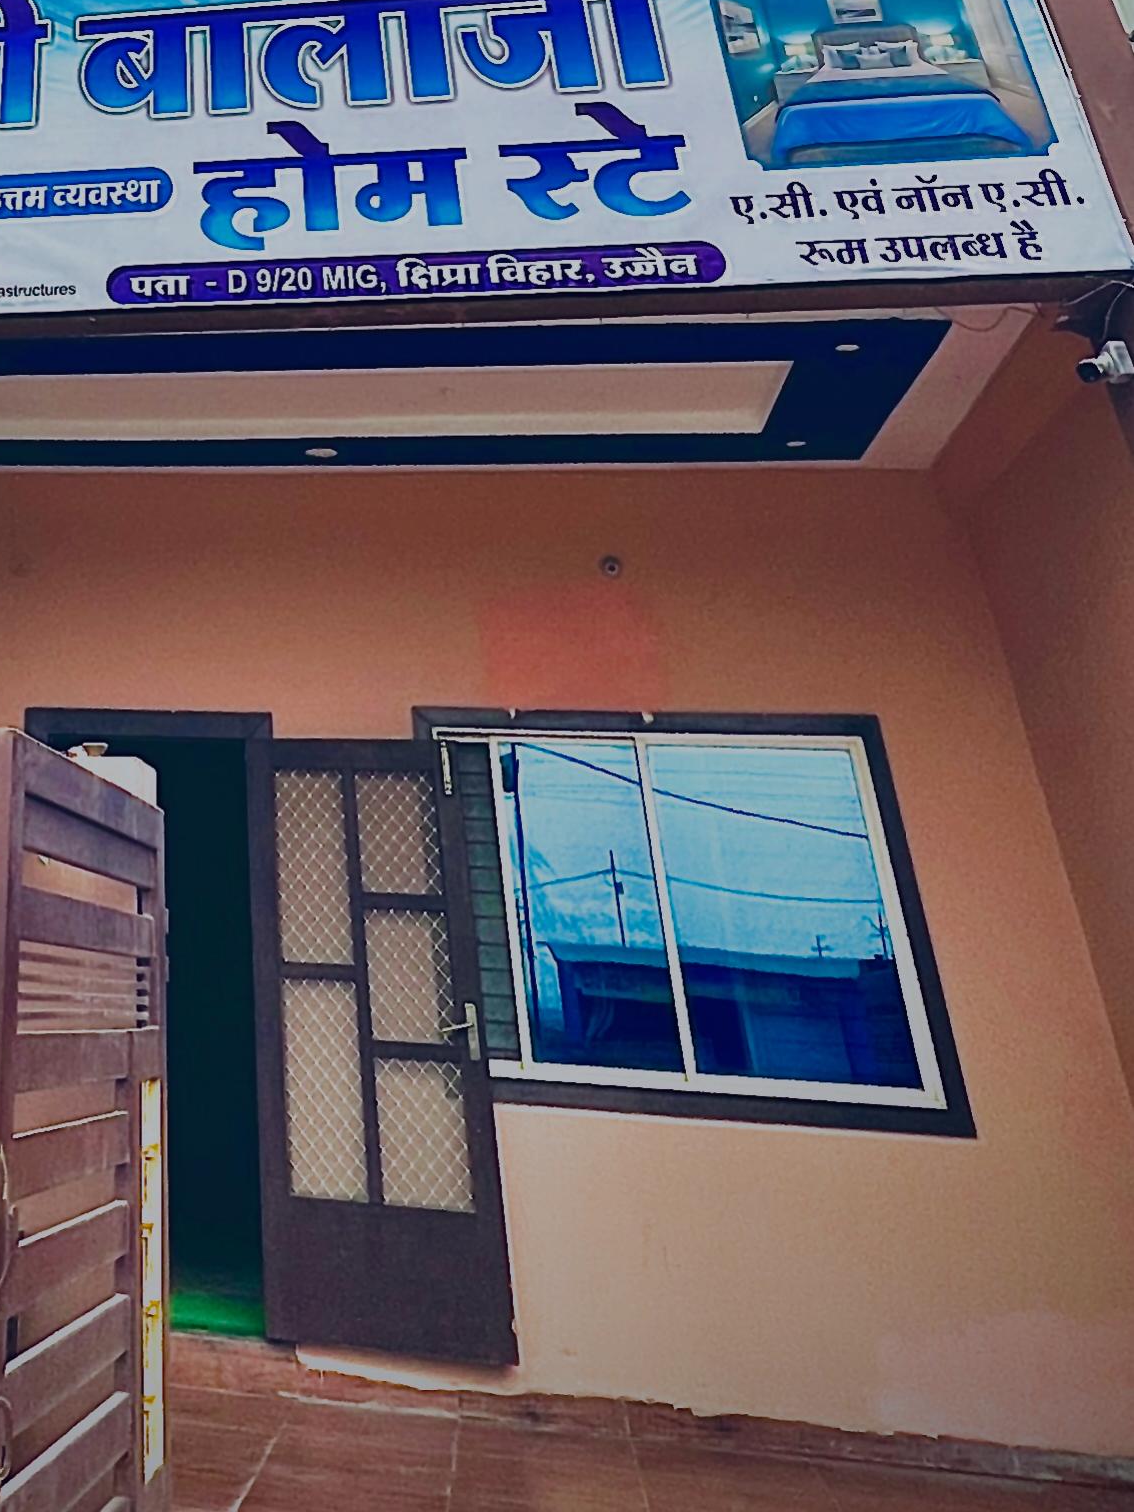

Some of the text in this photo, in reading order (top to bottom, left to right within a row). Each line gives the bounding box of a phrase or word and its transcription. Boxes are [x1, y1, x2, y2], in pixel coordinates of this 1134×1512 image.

[52, 179, 162, 208] व्यवस्था
[192, 102, 692, 251] होम स्टे
[730, 168, 1085, 225] ए.सी. एवं नॉन ए.सी.
[796, 219, 1044, 266] रूम उपलब्ध है
[129, 274, 191, 297] पता
[227, 269, 248, 294] D
[257, 266, 313, 293] 9/20
[322, 264, 387, 293] MIG,
[395, 257, 481, 289] क्षिप्रा
[486, 253, 596, 286] विहार,
[601, 246, 698, 280] उज्जैन
